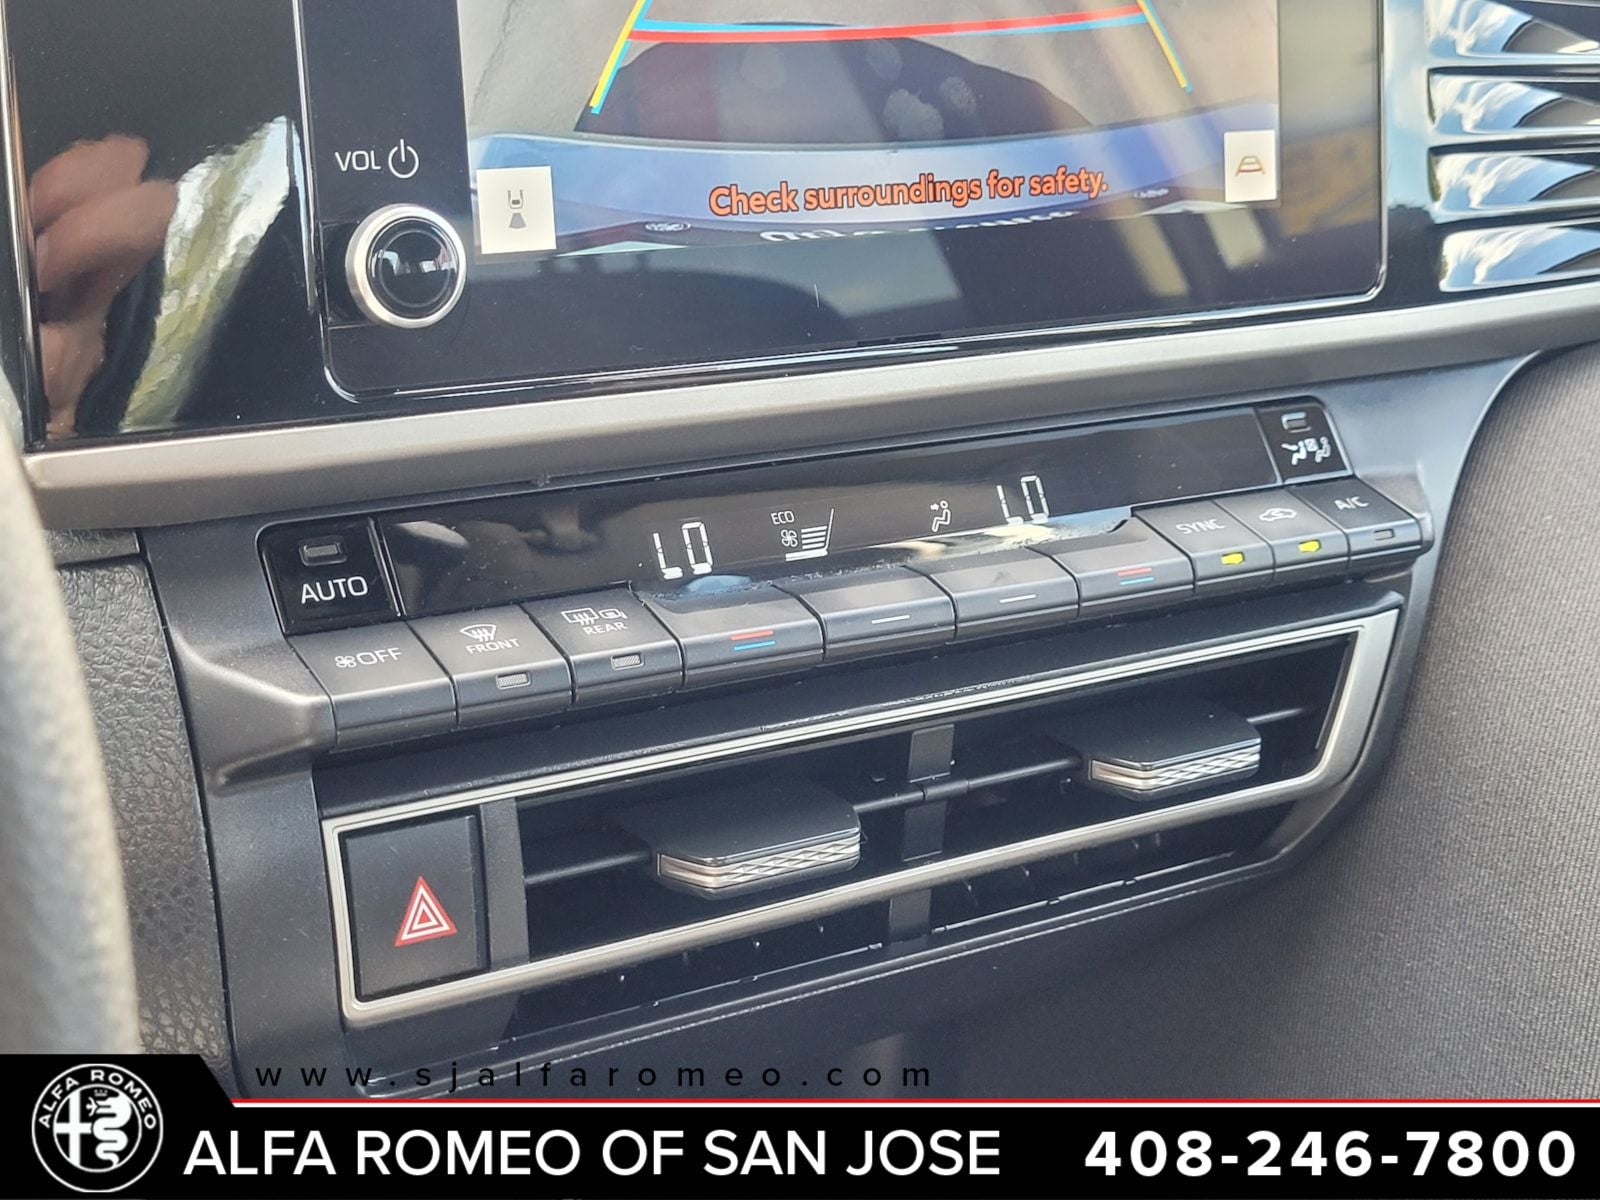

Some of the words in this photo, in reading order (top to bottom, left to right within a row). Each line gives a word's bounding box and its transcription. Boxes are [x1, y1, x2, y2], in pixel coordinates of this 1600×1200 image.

[335, 150, 381, 172] VOL
[709, 182, 797, 216] Check
[804, 171, 981, 210] surroundings
[987, 169, 1024, 198] for
[1029, 166, 1109, 199] safety.
[1334, 496, 1369, 511] A/C
[771, 510, 795, 526] ECO
[1176, 518, 1226, 535] SYNC
[300, 575, 368, 604] AUTO
[583, 620, 628, 636] REAR
[466, 637, 520, 655] FRONT
[354, 647, 402, 667] OFF
